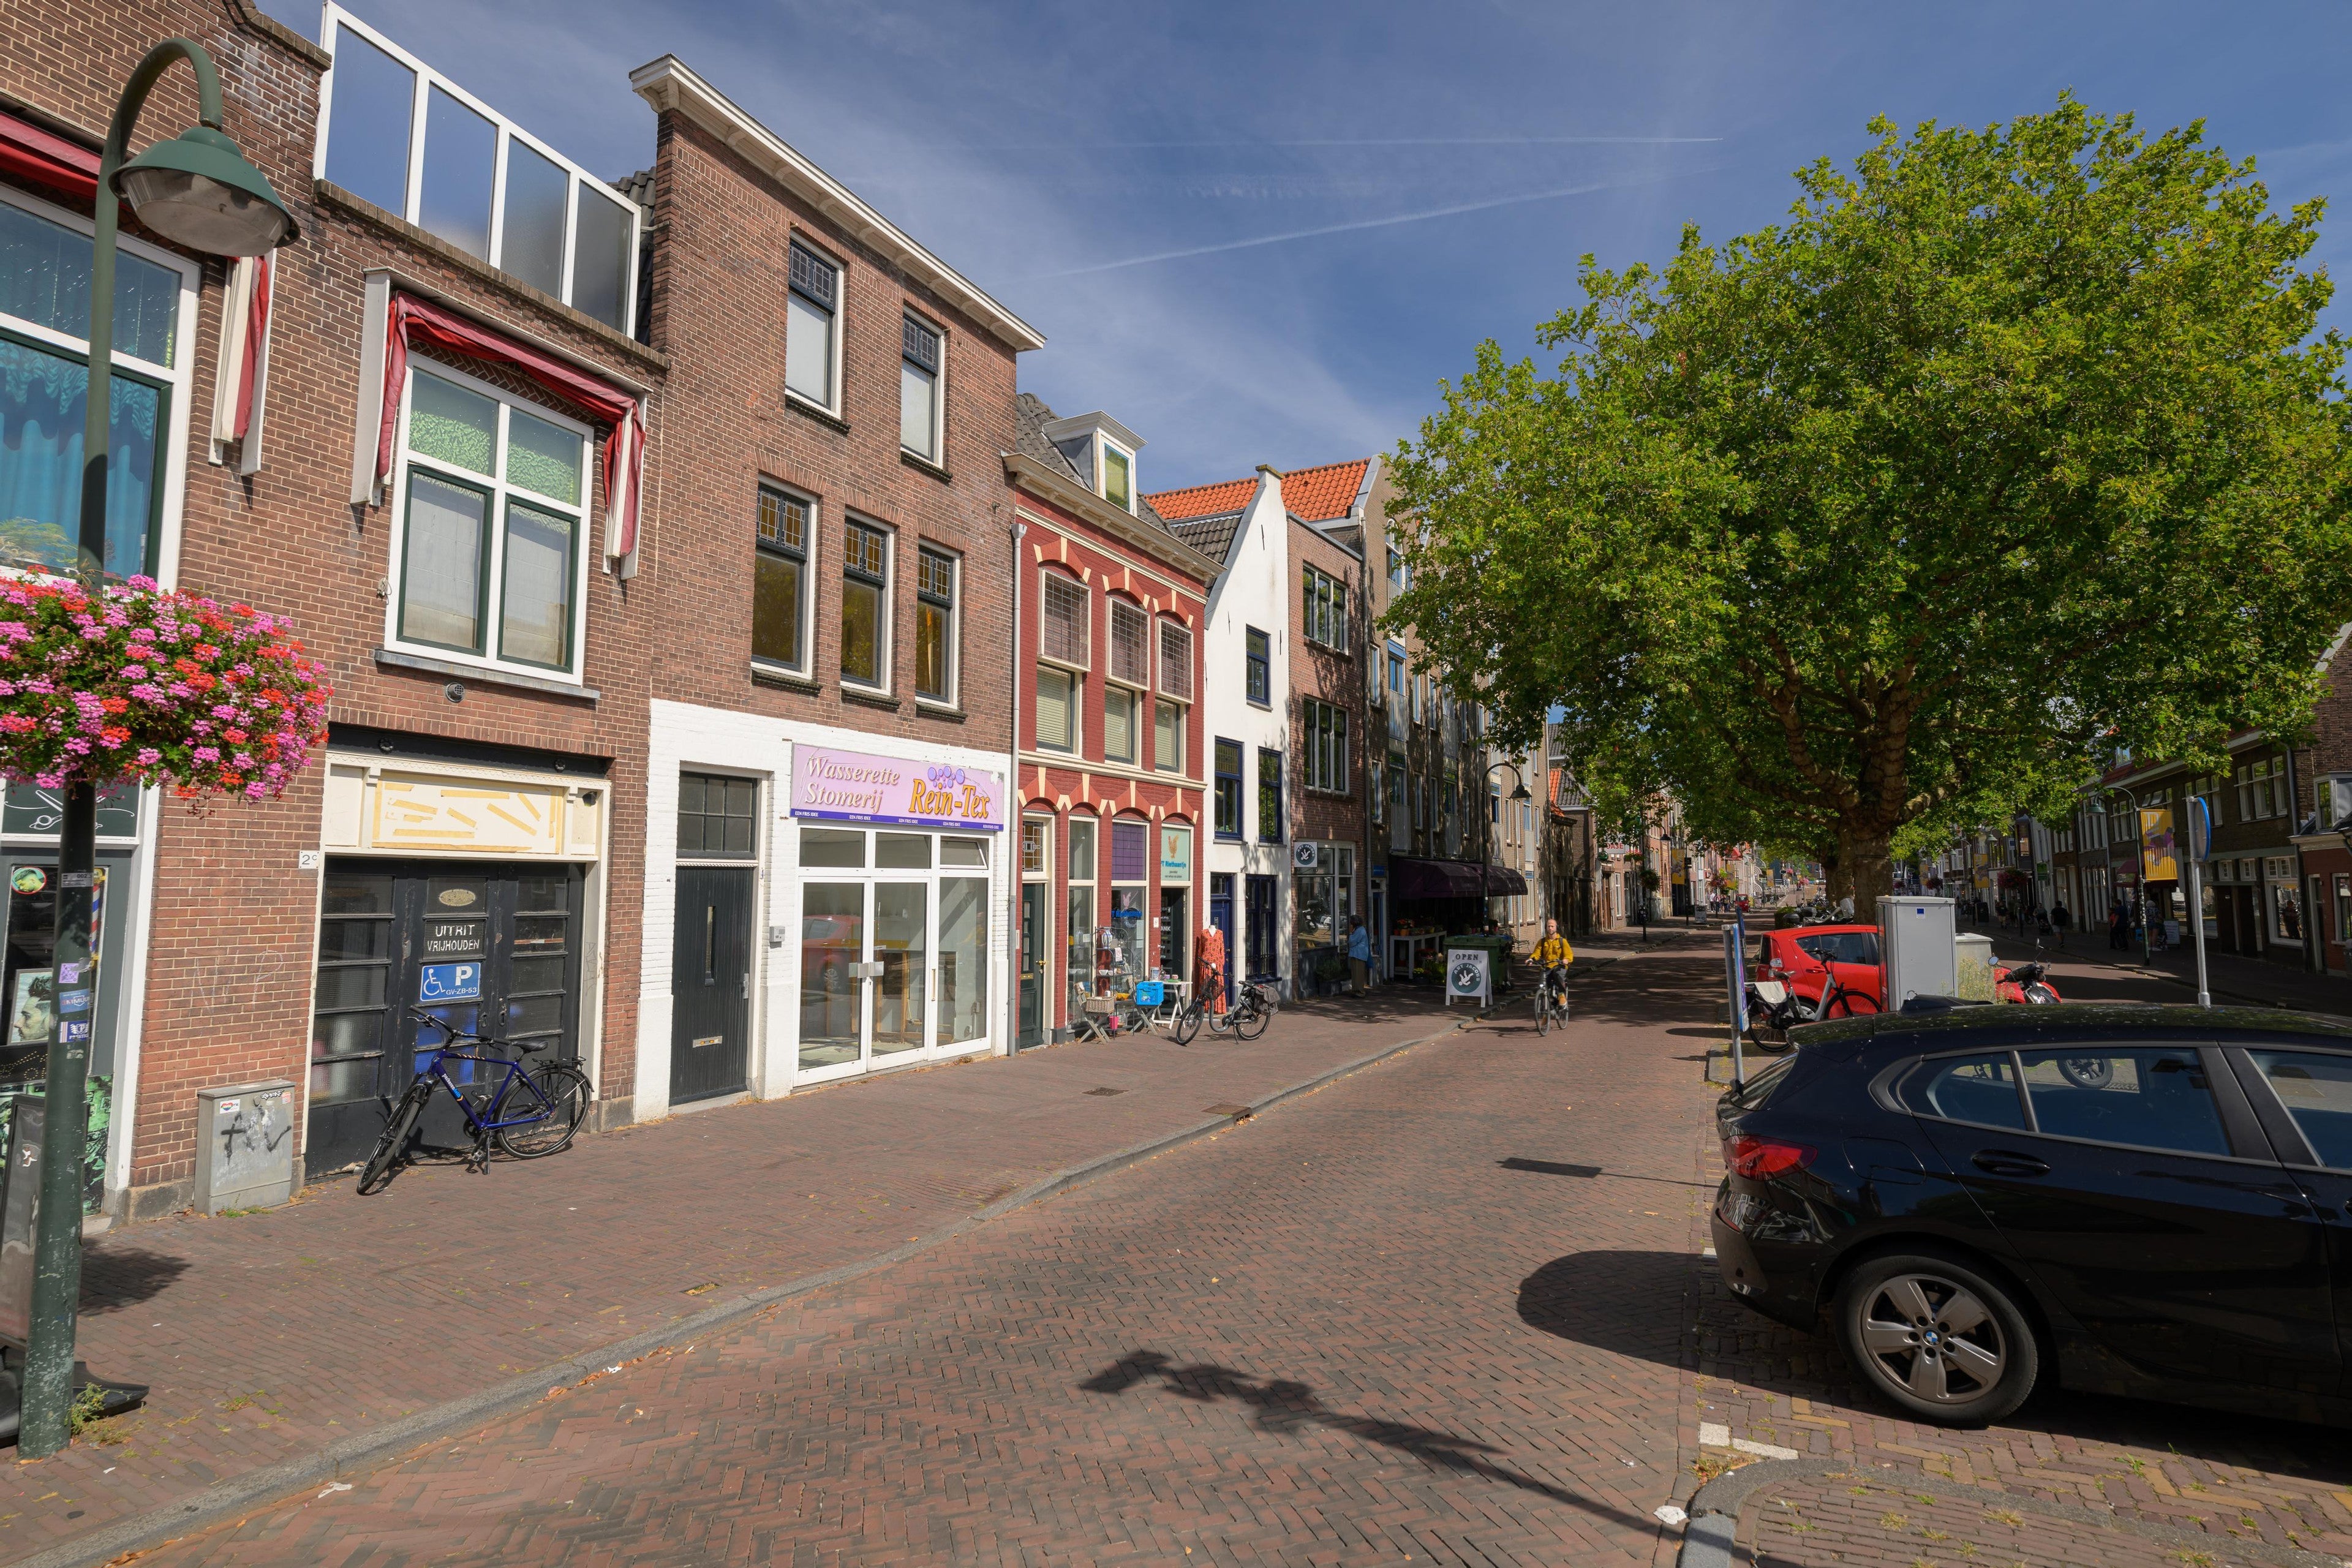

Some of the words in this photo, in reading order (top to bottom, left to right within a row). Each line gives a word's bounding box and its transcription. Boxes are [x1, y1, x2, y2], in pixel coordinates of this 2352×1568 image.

[808, 757, 900, 785] Wasserette
[804, 782, 883, 813] Stomerij
[908, 778, 990, 819] Rein-Tex
[435, 924, 475, 937] UITRIT
[427, 939, 480, 952] VRIJHOUDEN
[455, 966, 473, 986] P
[1453, 964, 1463, 974] ART
[1466, 964, 1480, 982] JACOBS
[446, 987, 477, 995] GV-ZB-53
